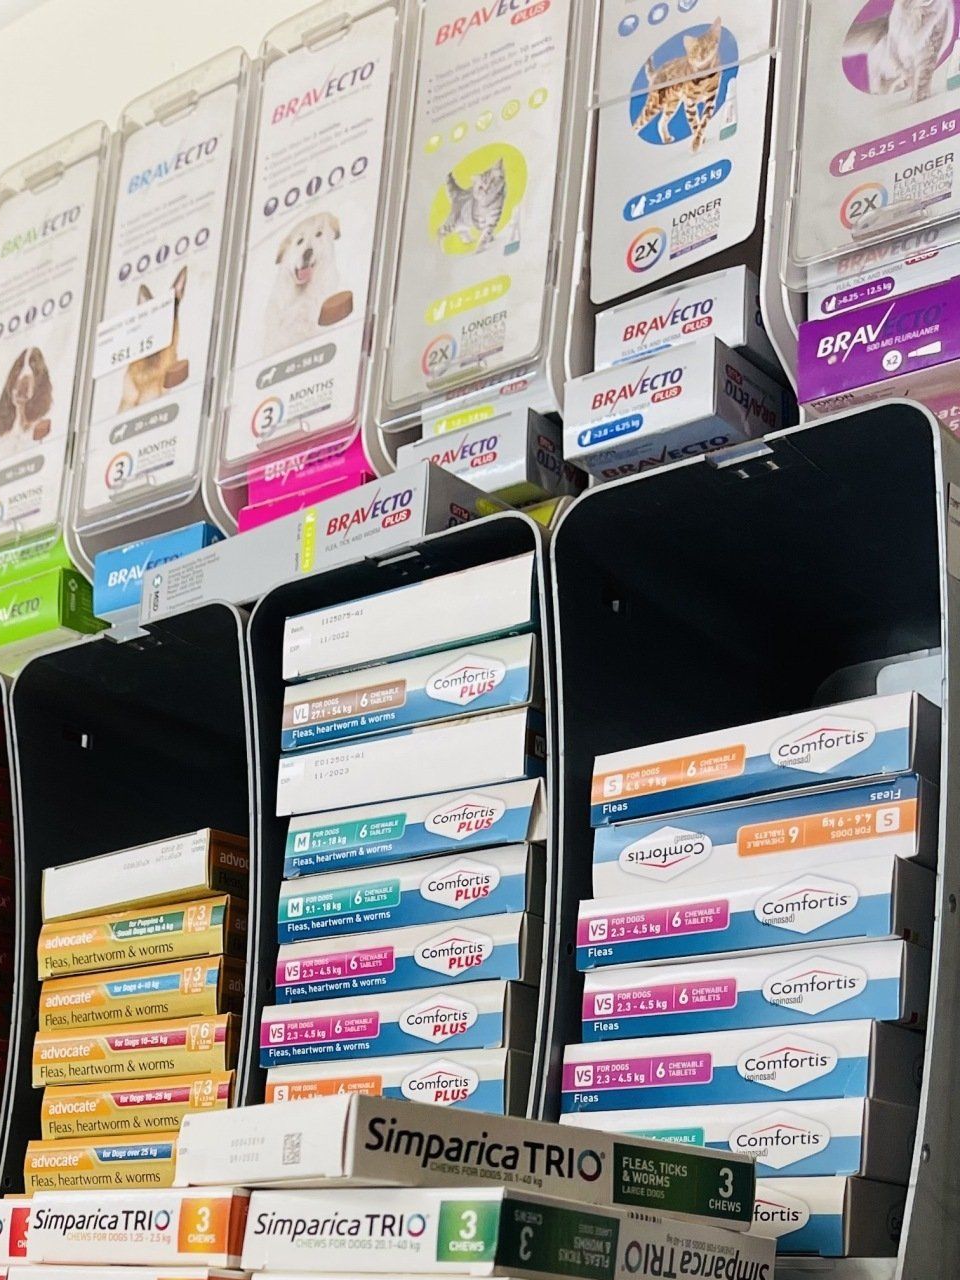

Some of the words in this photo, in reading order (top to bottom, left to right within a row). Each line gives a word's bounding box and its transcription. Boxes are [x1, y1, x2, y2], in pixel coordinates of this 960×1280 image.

[271, 62, 375, 125] BRAVECTO
[861, 140, 894, 161] >6.25
[912, 125, 938, 141] 12.5
[942, 118, 956, 133] kg
[126, 136, 218, 194] BRAVECTO
[894, 152, 954, 183] LONGER
[648, 191, 672, 205] >2.8
[685, 174, 707, 191] 6.25
[710, 167, 722, 180] kg
[672, 198, 721, 227] LONGER
[850, 193, 878, 219] 2X
[0, 205, 82, 258] BRAVECTO
[634, 238, 658, 262] 2X
[461, 309, 507, 336] LONGER
[622, 295, 713, 345] BRAVECTO
[684, 318, 710, 331] PLUS
[429, 348, 449, 367] 2X
[290, 379, 334, 403] MONTHS
[591, 366, 684, 413] BRAVECTO
[654, 388, 680, 402] PLUS
[261, 406, 274, 428] 3
[139, 437, 177, 456] MONTHS
[473, 453, 494, 466] PLUS
[112, 461, 124, 482] 3
[326, 488, 413, 539] BRAVECTO
[384, 510, 408, 528] PLUS
[433, 668, 496, 690] Comfortis
[460, 680, 495, 698] PLUS
[360, 693, 368, 707] 6
[294, 709, 308, 720] VL
[292, 725, 314, 739] Fleas,
[316, 718, 358, 735] heartworm
[360, 716, 366, 725] &
[368, 711, 395, 725] worms
[778, 730, 866, 758] Comfortis
[433, 807, 494, 826] Comfortis
[603, 801, 628, 813] Fleas
[457, 818, 492, 833] PLUS
[626, 843, 705, 863] Comfortis
[428, 875, 490, 893] Comfortis
[455, 885, 490, 901] PLUS
[762, 893, 848, 916] Comfortis
[612, 917, 625, 925] FOR
[627, 914, 645, 924] DOGS
[672, 912, 681, 928] 6
[685, 907, 721, 920] CHEWABLE
[684, 914, 713, 925] TABLETS
[591, 924, 606, 936] VS
[611, 927, 625, 938] 2.3
[633, 925, 646, 936] 4.5
[648, 923, 660, 936] kg
[45, 932, 94, 949] advocate
[45, 956, 68, 970] Fleas,
[72, 948, 126, 966] heartworm
[127, 947, 135, 958] &
[137, 942, 174, 955] worms
[421, 942, 483, 960] Comfortis
[286, 965, 299, 977] VS
[448, 954, 482, 969] PLUS
[770, 973, 857, 996] Comfortis
[406, 1011, 468, 1026] Comfortis
[287, 1031, 298, 1040] 2.3
[305, 1030, 316, 1039] 4.5
[317, 1029, 326, 1039] kg
[269, 1046, 290, 1057] Fleas,
[292, 1043, 333, 1055] heartworm
[336, 1043, 341, 1051] &
[343, 1041, 370, 1050] worms
[49, 1100, 96, 1115] advocate
[365, 1117, 518, 1171] Simparica
[522, 1140, 603, 1183] TRIO
[31, 1154, 80, 1169] advocate
[623, 1157, 656, 1173] FLEAS,
[659, 1161, 688, 1177] TICKS
[623, 1170, 630, 1183] &
[632, 1172, 670, 1187] WORMS
[718, 1167, 733, 1198] 3
[622, 1185, 645, 1197] LARGE
[646, 1187, 665, 1199] DOGS
[709, 1199, 741, 1212] CHEWS
[33, 1209, 117, 1235] Simparica
[118, 1210, 171, 1231] TRIO
[196, 1207, 211, 1232] 3
[254, 1212, 361, 1243] Simparica
[365, 1212, 427, 1237] TRIO
[188, 1233, 216, 1245] CHEWS
[624, 1240, 676, 1279] TRIO
